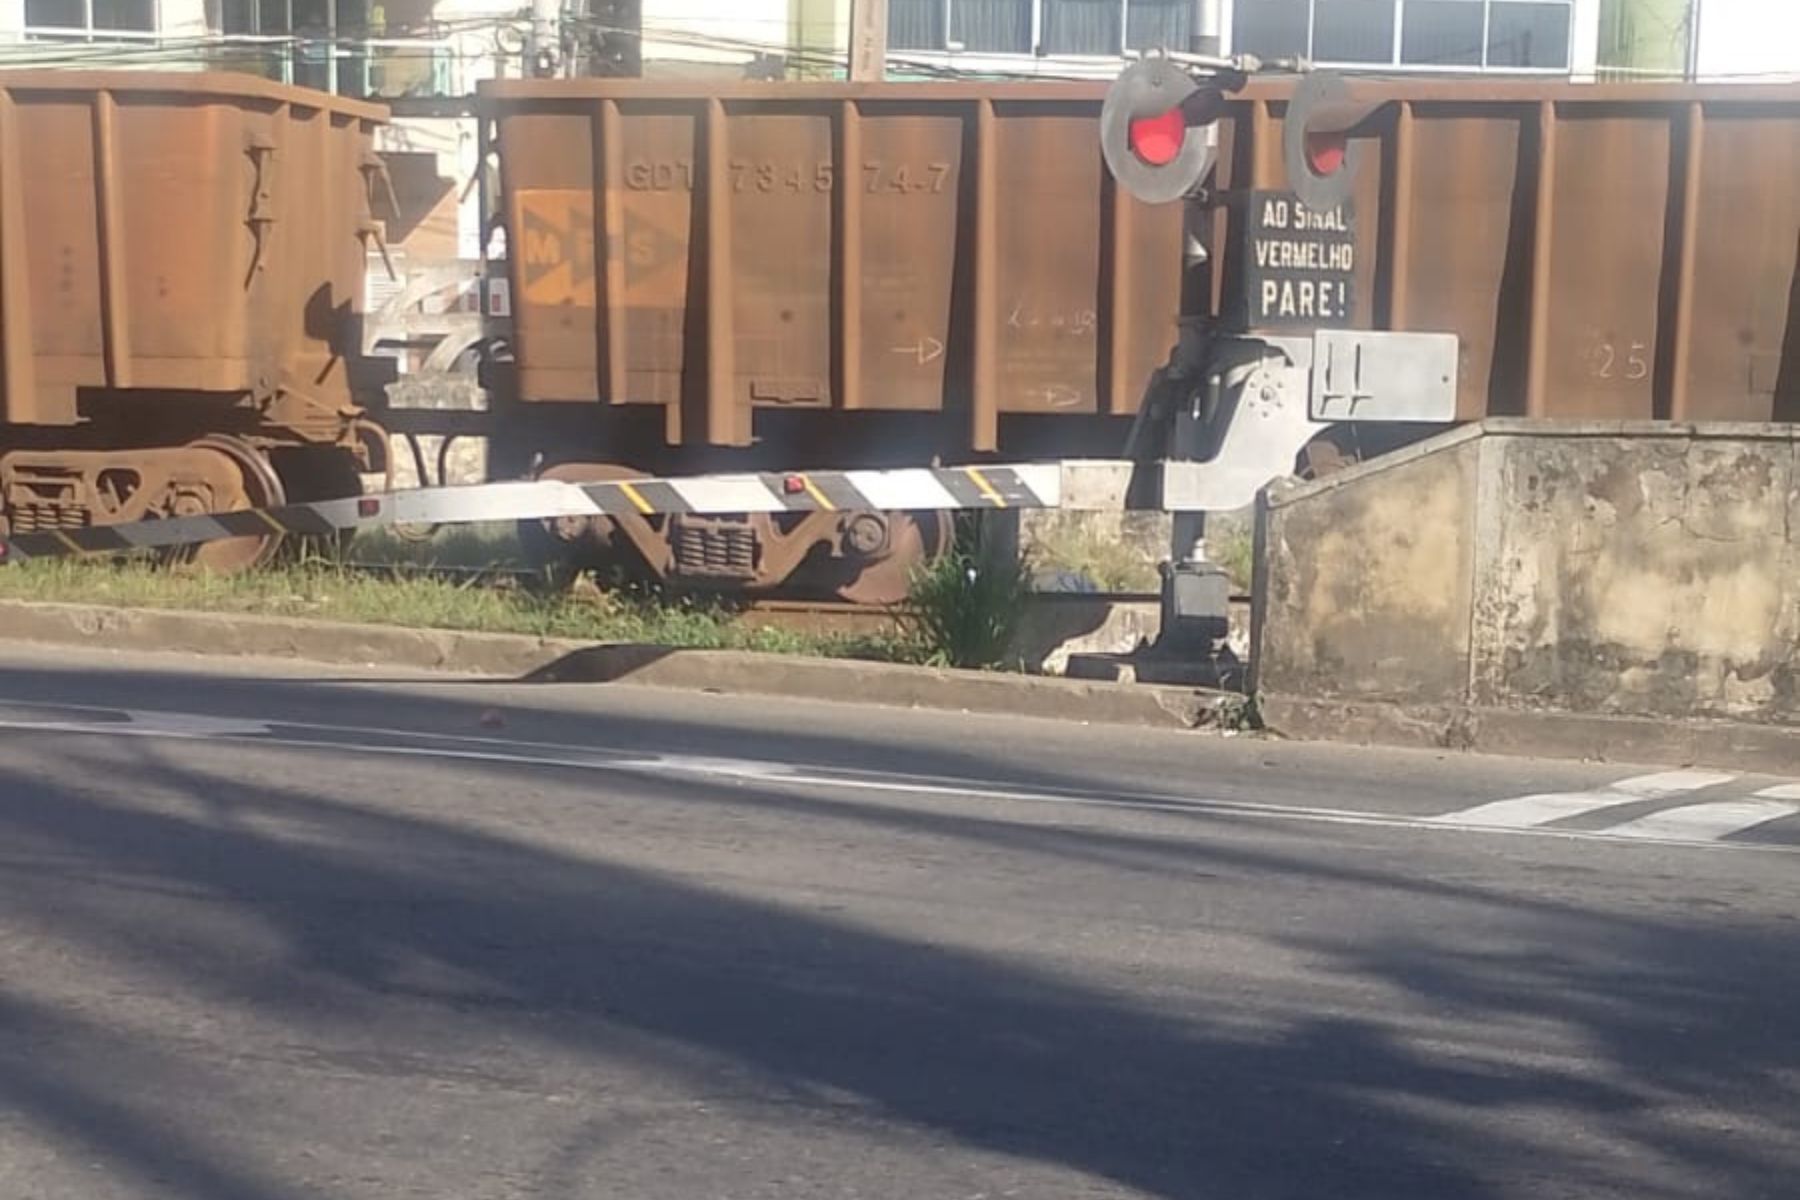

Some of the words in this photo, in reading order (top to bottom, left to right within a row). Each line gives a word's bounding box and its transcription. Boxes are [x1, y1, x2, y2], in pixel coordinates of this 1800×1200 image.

[1263, 200, 1288, 229] AO
[1294, 201, 1347, 231] SINAL
[1255, 239, 1353, 271] VERMELHO
[1262, 280, 1345, 318] PARE!
